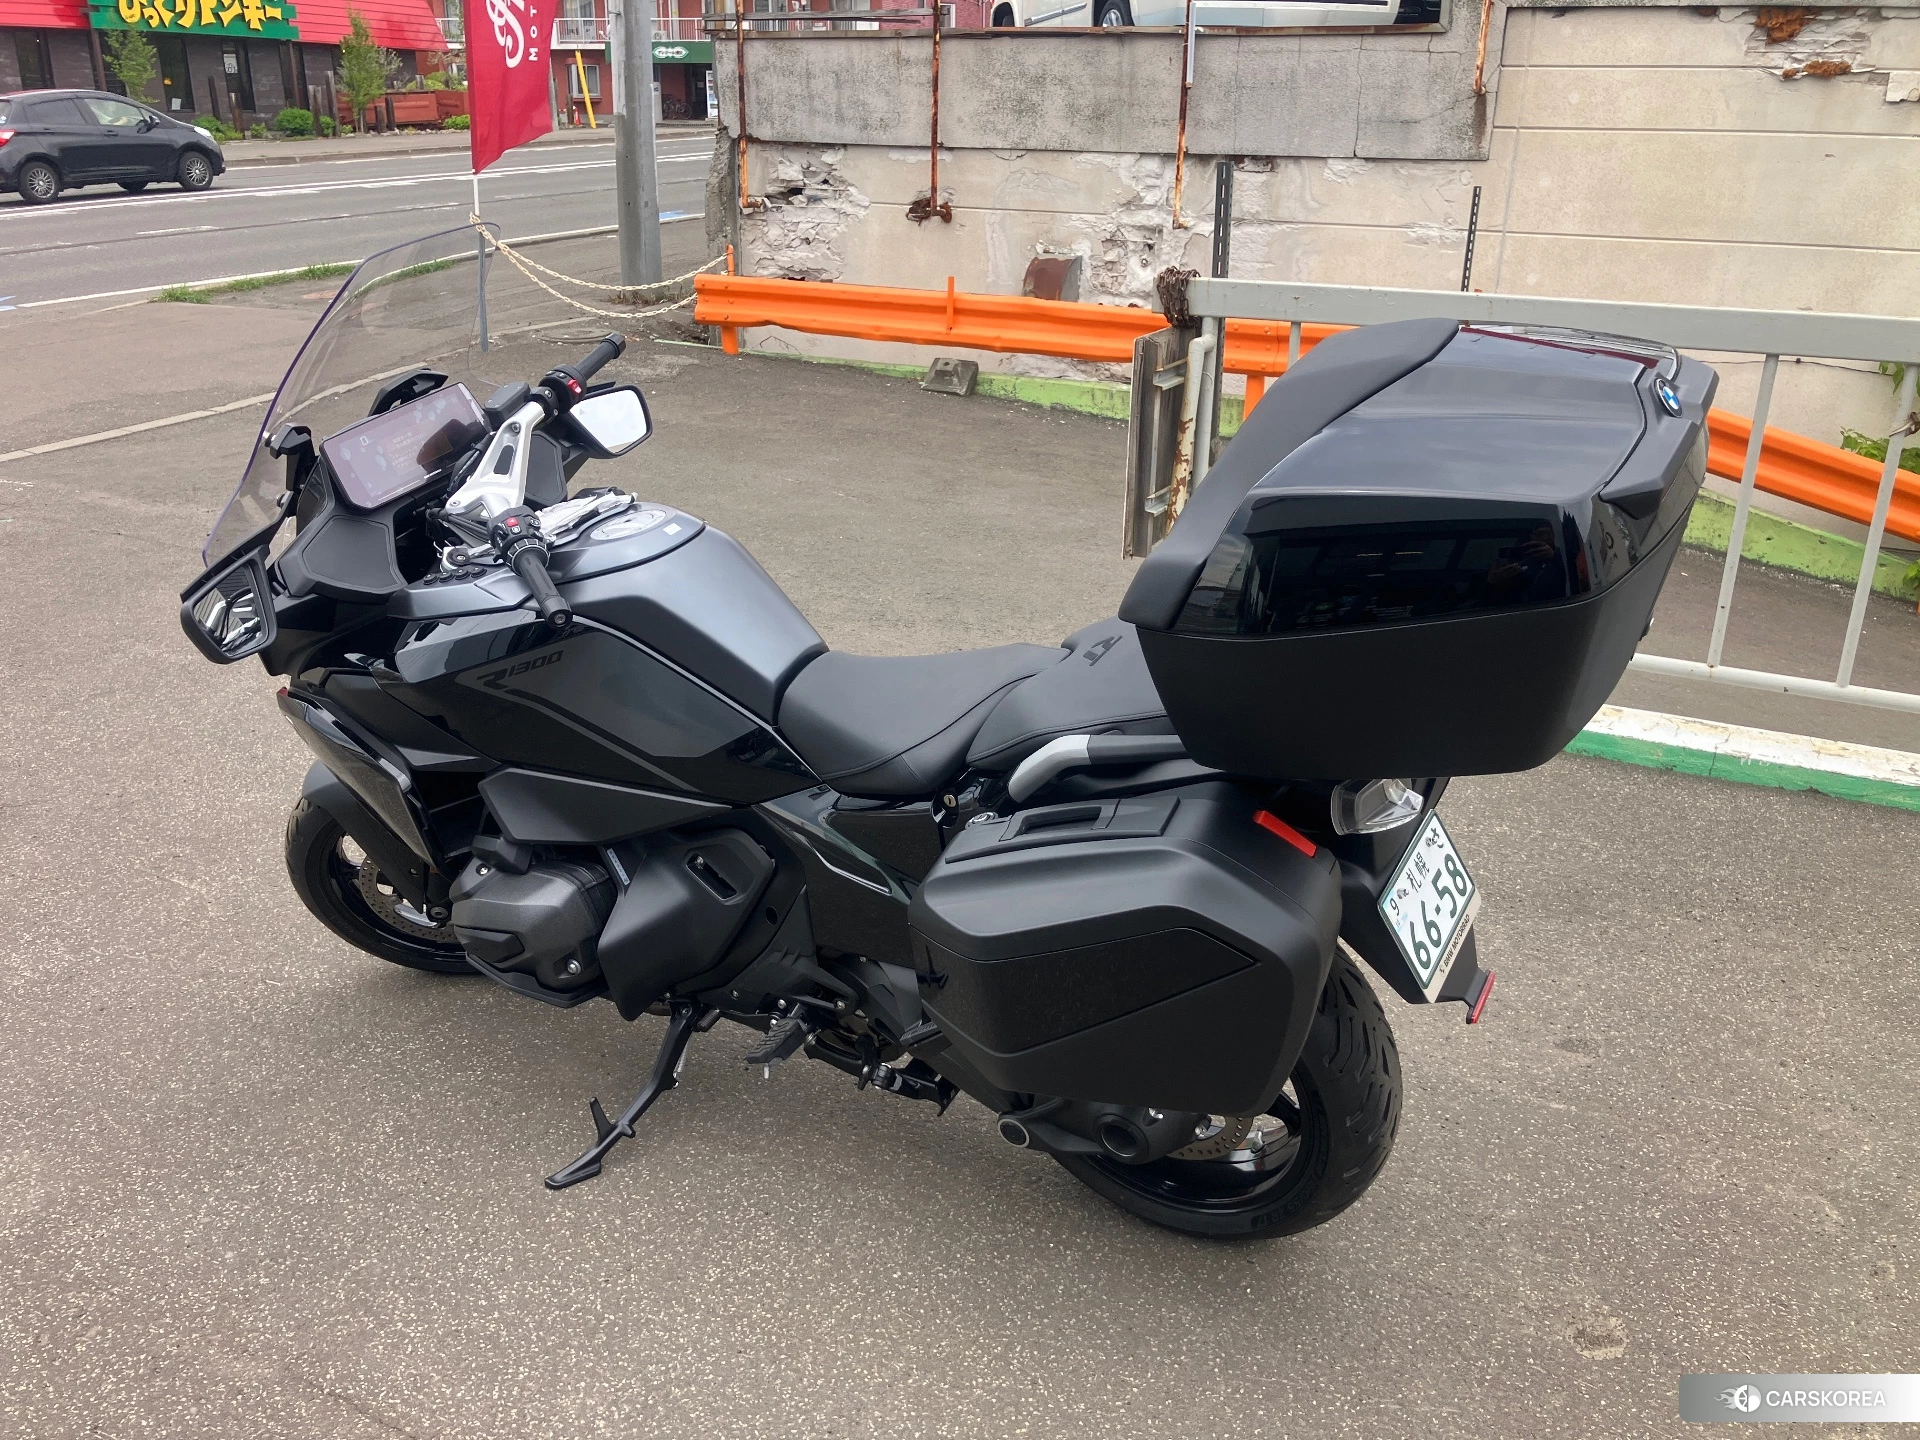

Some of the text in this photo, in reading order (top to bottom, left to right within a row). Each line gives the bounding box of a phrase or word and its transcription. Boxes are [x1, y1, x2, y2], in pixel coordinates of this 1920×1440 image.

[1405, 851, 1430, 893] 札幌
[1389, 897, 1400, 917] 9
[1443, 947, 1454, 967] BMW
